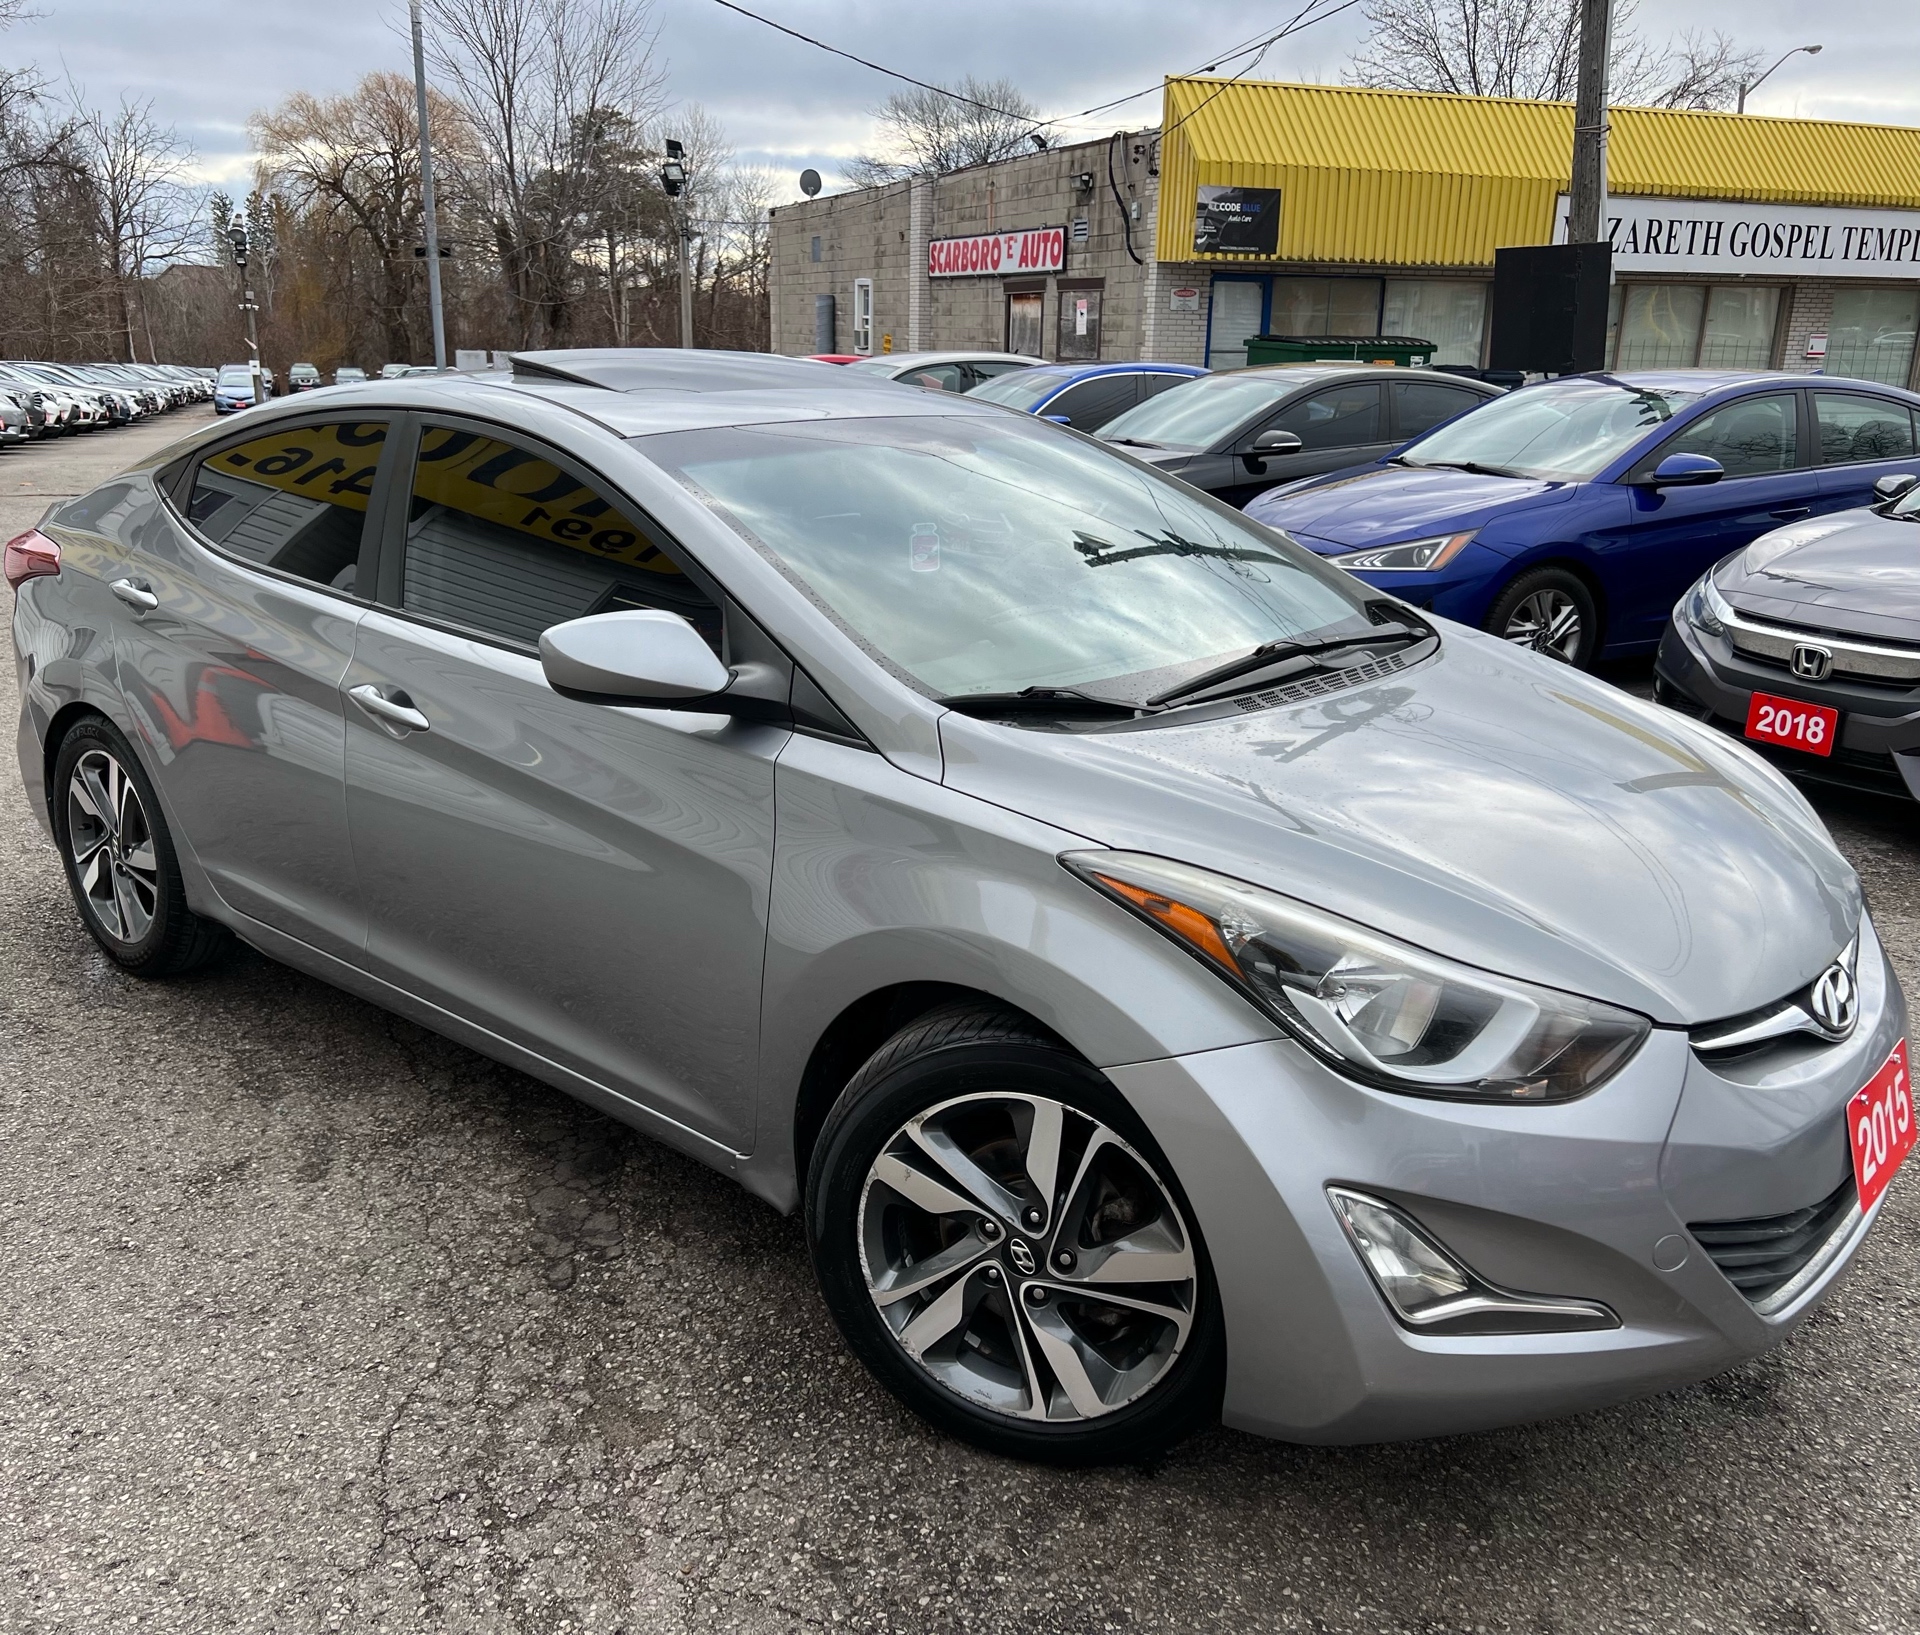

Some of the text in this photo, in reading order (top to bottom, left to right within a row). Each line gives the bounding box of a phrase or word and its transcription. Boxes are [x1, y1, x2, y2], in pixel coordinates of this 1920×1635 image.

[1219, 202, 1261, 213] CODE BLUE
[929, 236, 1002, 274] SCARBORO
[1018, 230, 1063, 268] AUTO
[1563, 216, 1725, 256] ZARETH
[1729, 221, 1836, 260] GOSPEL
[1755, 705, 1825, 744] 2018
[1857, 1068, 1909, 1186] 2015
